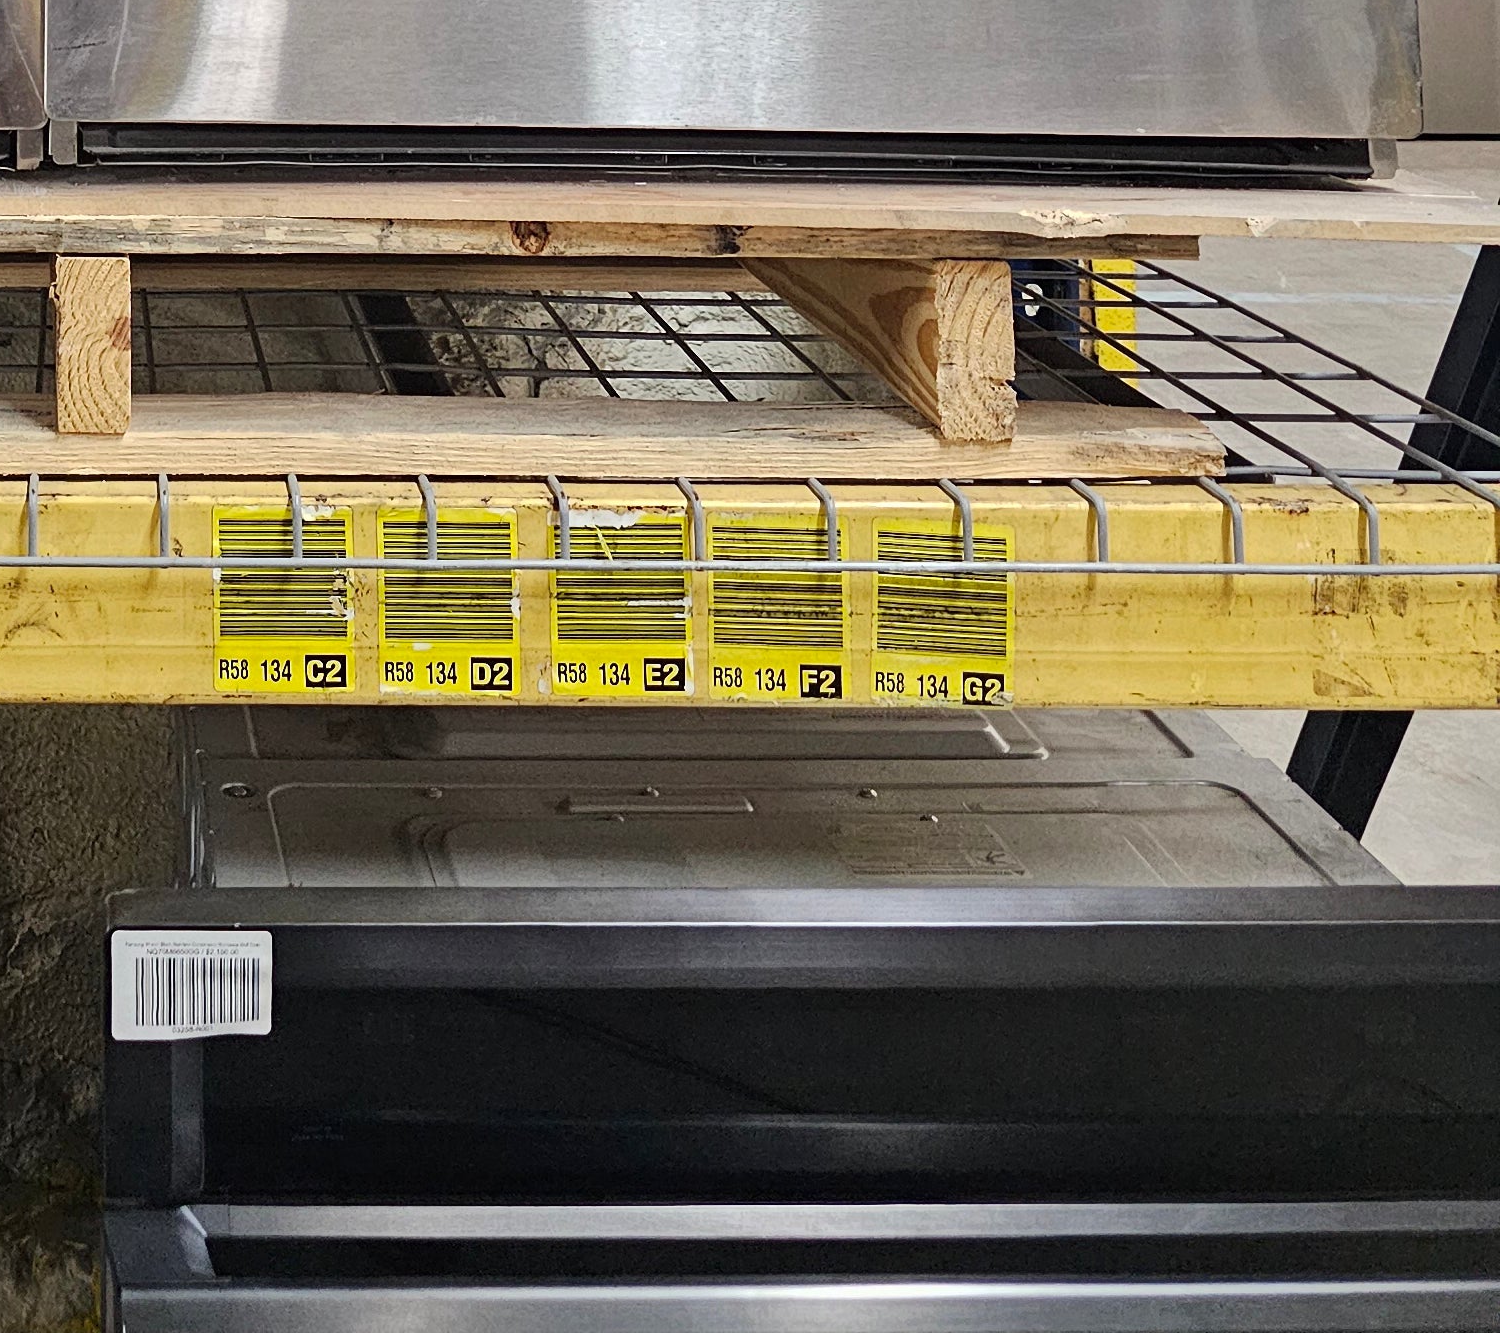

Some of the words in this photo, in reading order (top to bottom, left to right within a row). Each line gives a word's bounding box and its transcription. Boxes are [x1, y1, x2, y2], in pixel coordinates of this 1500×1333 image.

[219, 659, 249, 681] R58
[260, 659, 293, 683] 134
[305, 659, 343, 683] C2
[384, 661, 414, 683] R58
[425, 661, 458, 685] 134
[472, 662, 510, 686] D2
[557, 662, 588, 684] R58
[598, 662, 631, 686] 134
[645, 663, 681, 686] E2
[713, 666, 743, 688] R58
[754, 668, 787, 692] 134
[801, 669, 836, 694] F2
[875, 671, 905, 694] R58
[916, 674, 949, 699] 134
[964, 676, 1002, 702] G2
